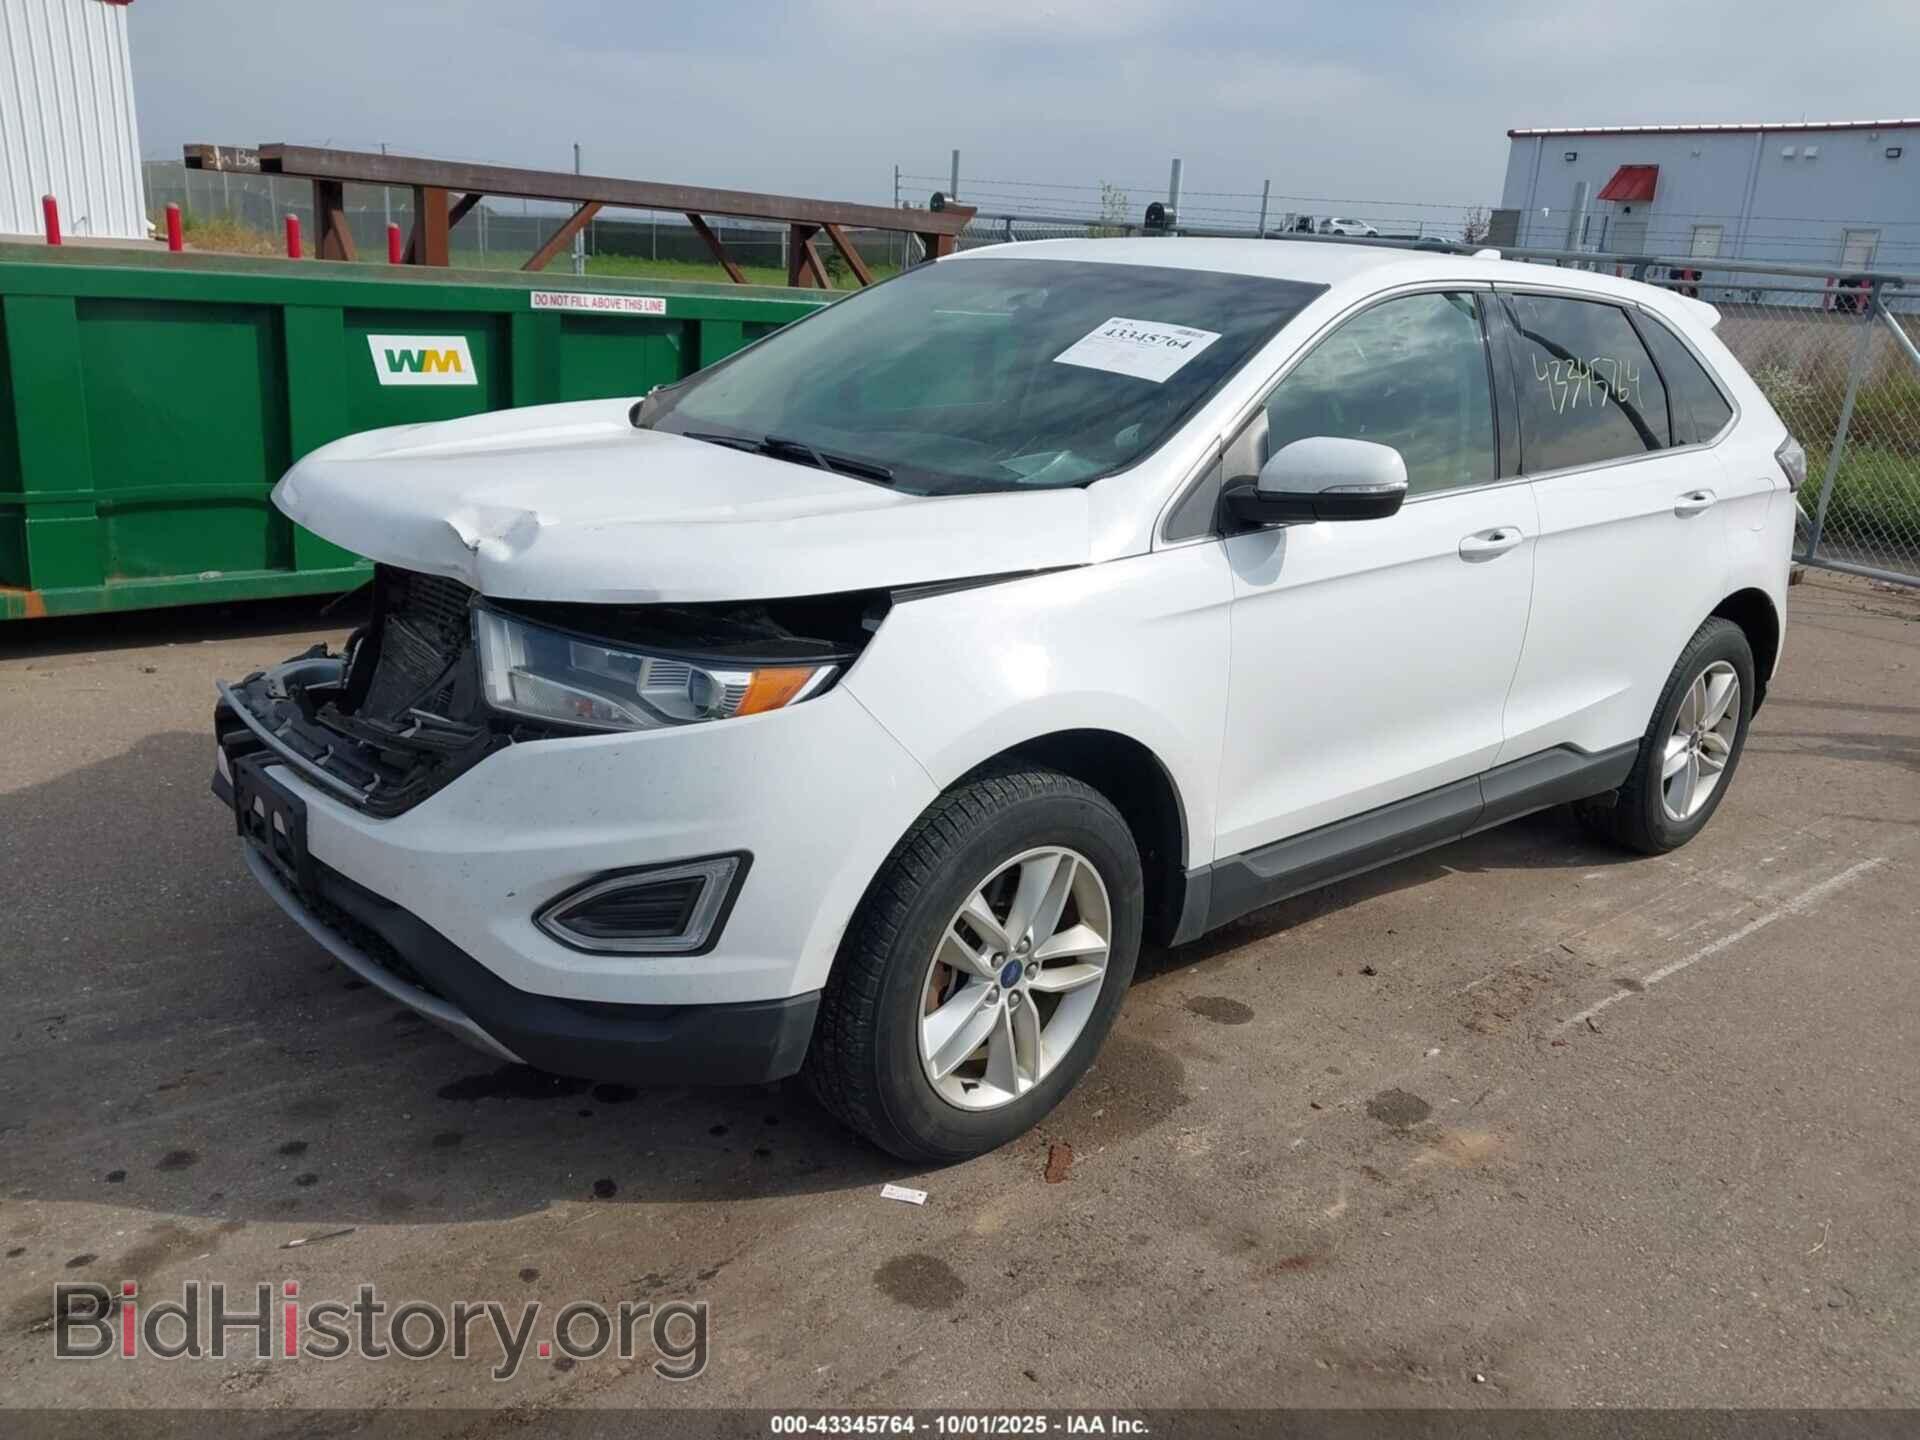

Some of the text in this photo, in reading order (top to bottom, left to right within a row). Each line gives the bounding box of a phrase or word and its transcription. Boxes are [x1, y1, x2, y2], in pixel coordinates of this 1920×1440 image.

[534, 293, 664, 312] DO NOT FILL ABOVE THIS LINE
[1104, 328, 1192, 349] 43345764
[384, 348, 464, 374] WM
[1531, 352, 1644, 415] 43345764
